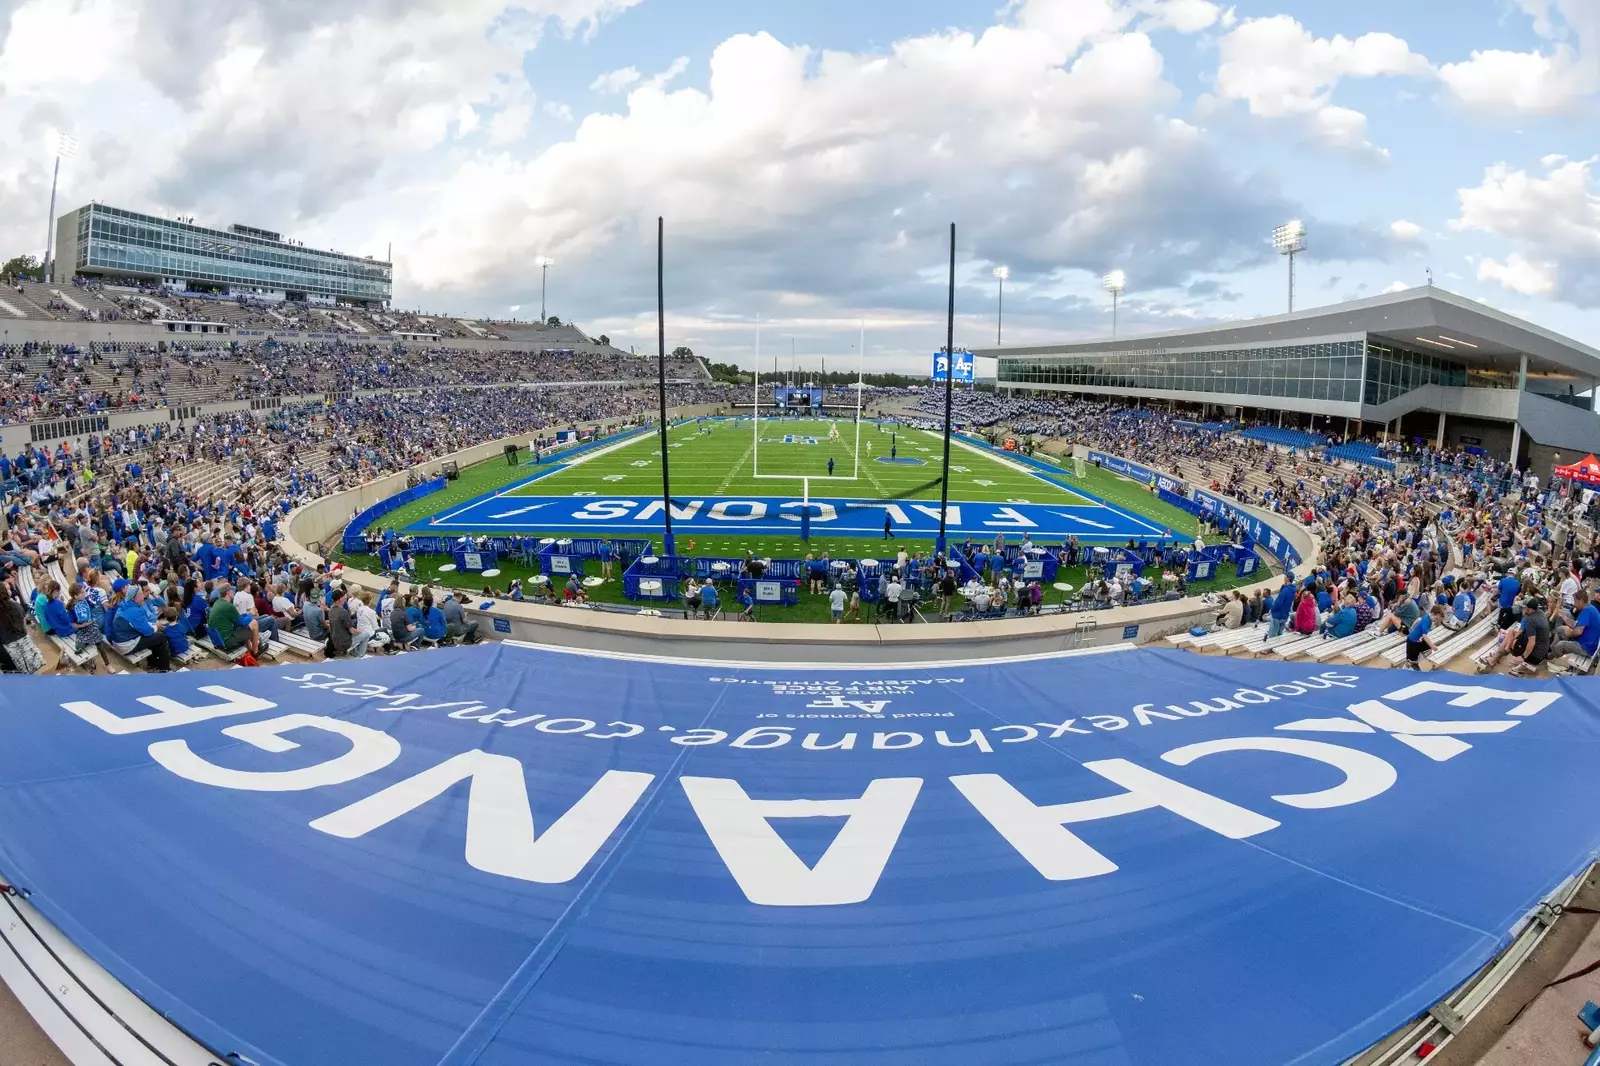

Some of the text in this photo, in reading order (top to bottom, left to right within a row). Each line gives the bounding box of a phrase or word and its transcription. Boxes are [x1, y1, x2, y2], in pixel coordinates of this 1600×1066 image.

[708, 676, 965, 686] ACADEMY ATHLETICS
[806, 695, 892, 713] AF
[60, 681, 1562, 905] EXCHANGE
